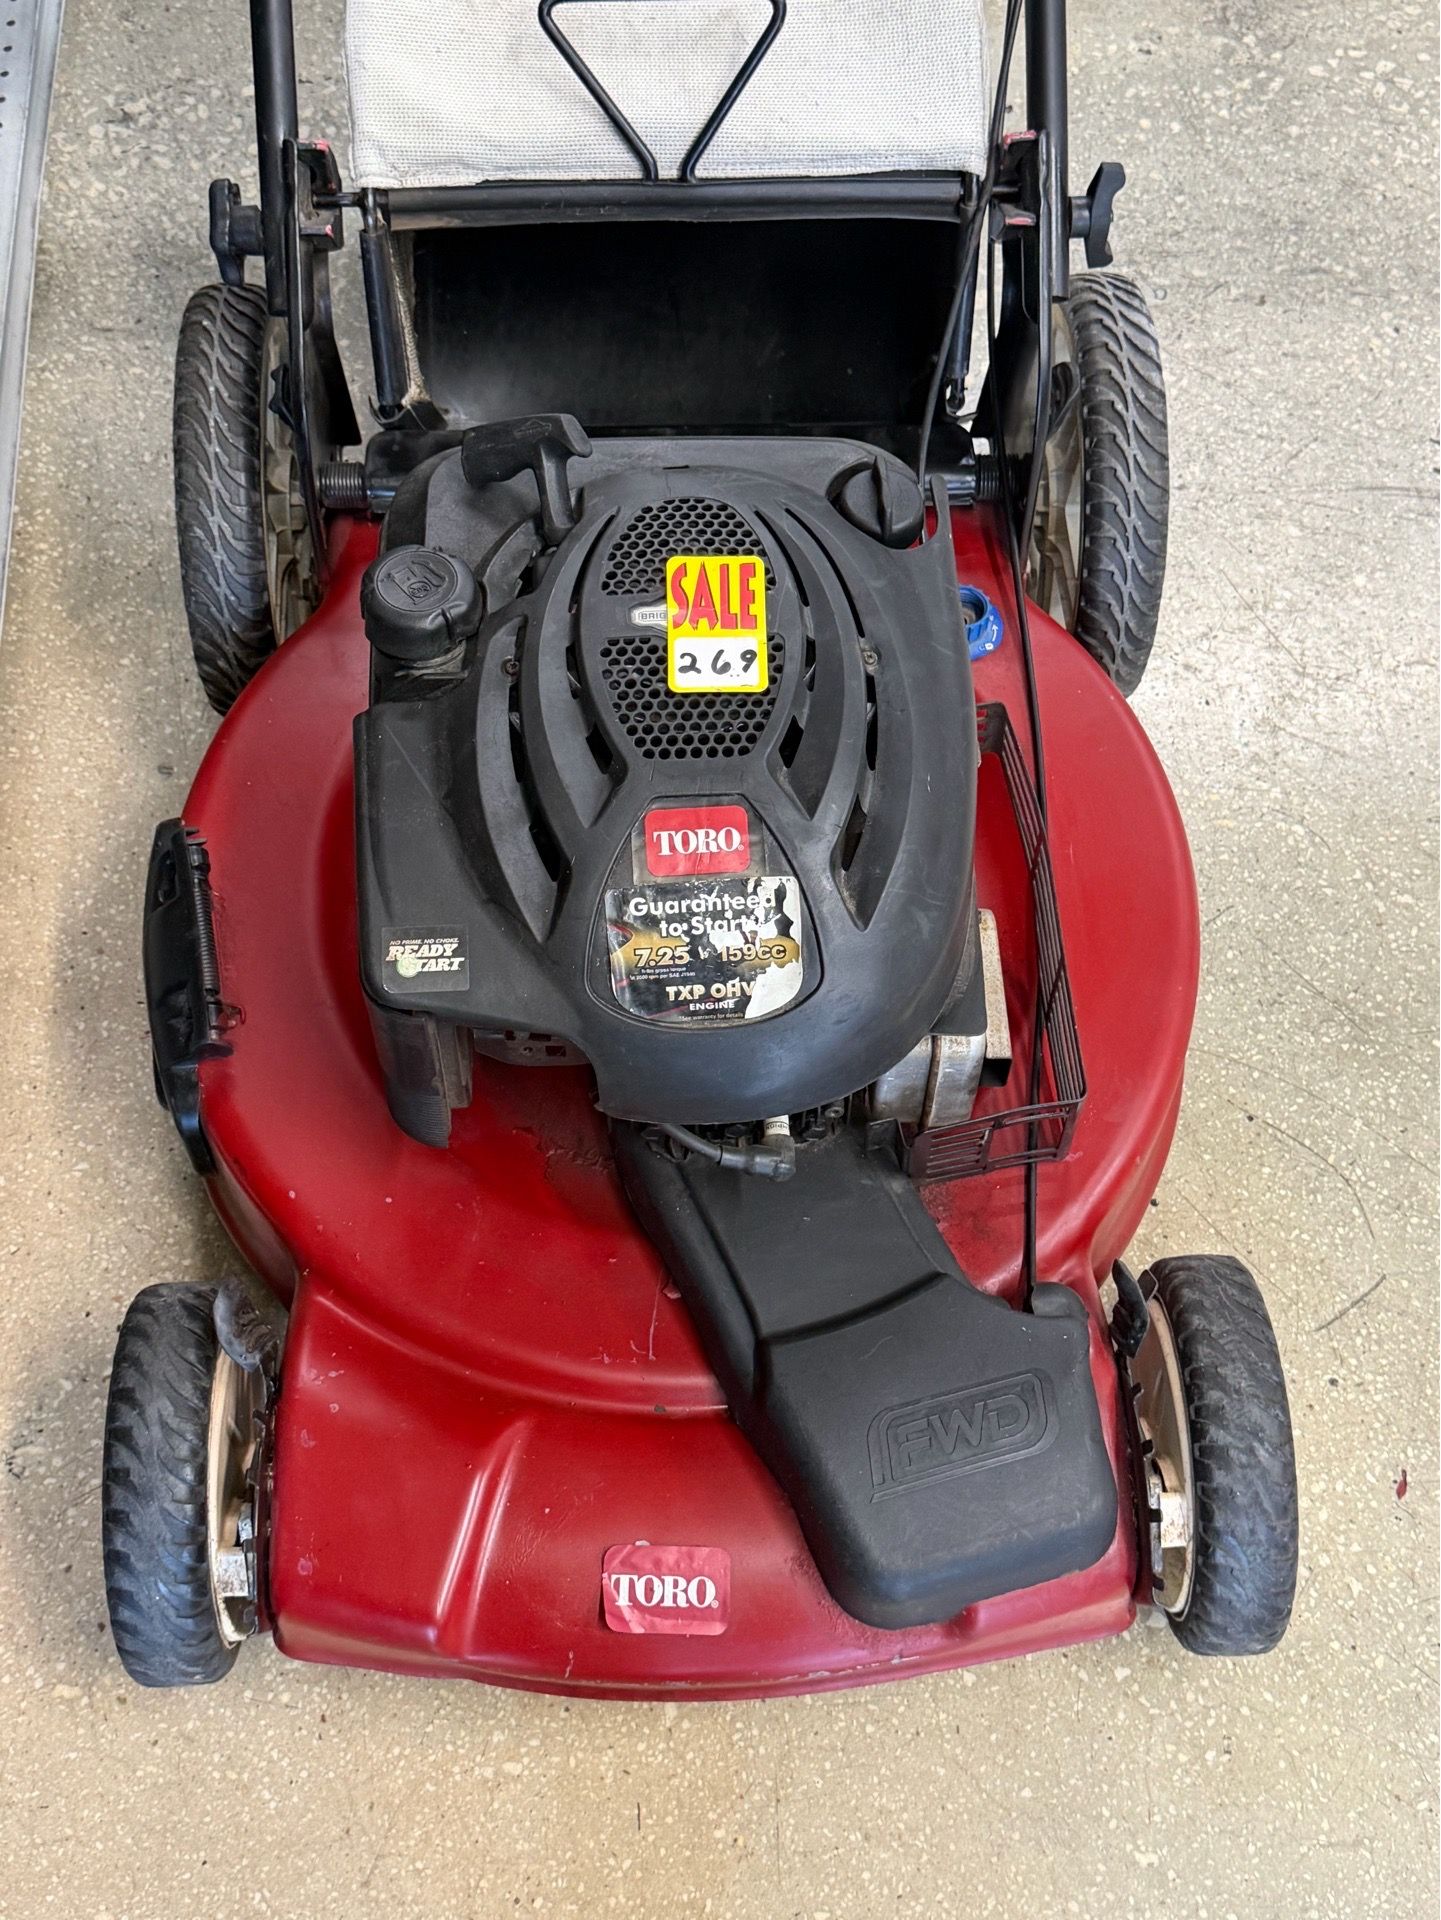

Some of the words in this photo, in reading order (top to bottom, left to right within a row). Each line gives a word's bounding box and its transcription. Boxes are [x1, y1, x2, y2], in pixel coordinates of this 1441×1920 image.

[671, 560, 757, 631] SALE
[641, 612, 667, 620] BRIG
[652, 826, 743, 856] TORO
[629, 893, 776, 916] Guaranteed
[659, 920, 683, 937] to
[385, 943, 459, 961] READY
[633, 945, 691, 968] 7.25
[719, 944, 787, 963] 159cc
[397, 957, 465, 978] TART
[666, 984, 706, 1001] TXP
[710, 981, 756, 999] OHV
[689, 1000, 736, 1011] ENGINE
[896, 1394, 1030, 1470] FWD
[610, 1574, 718, 1608] TORO
